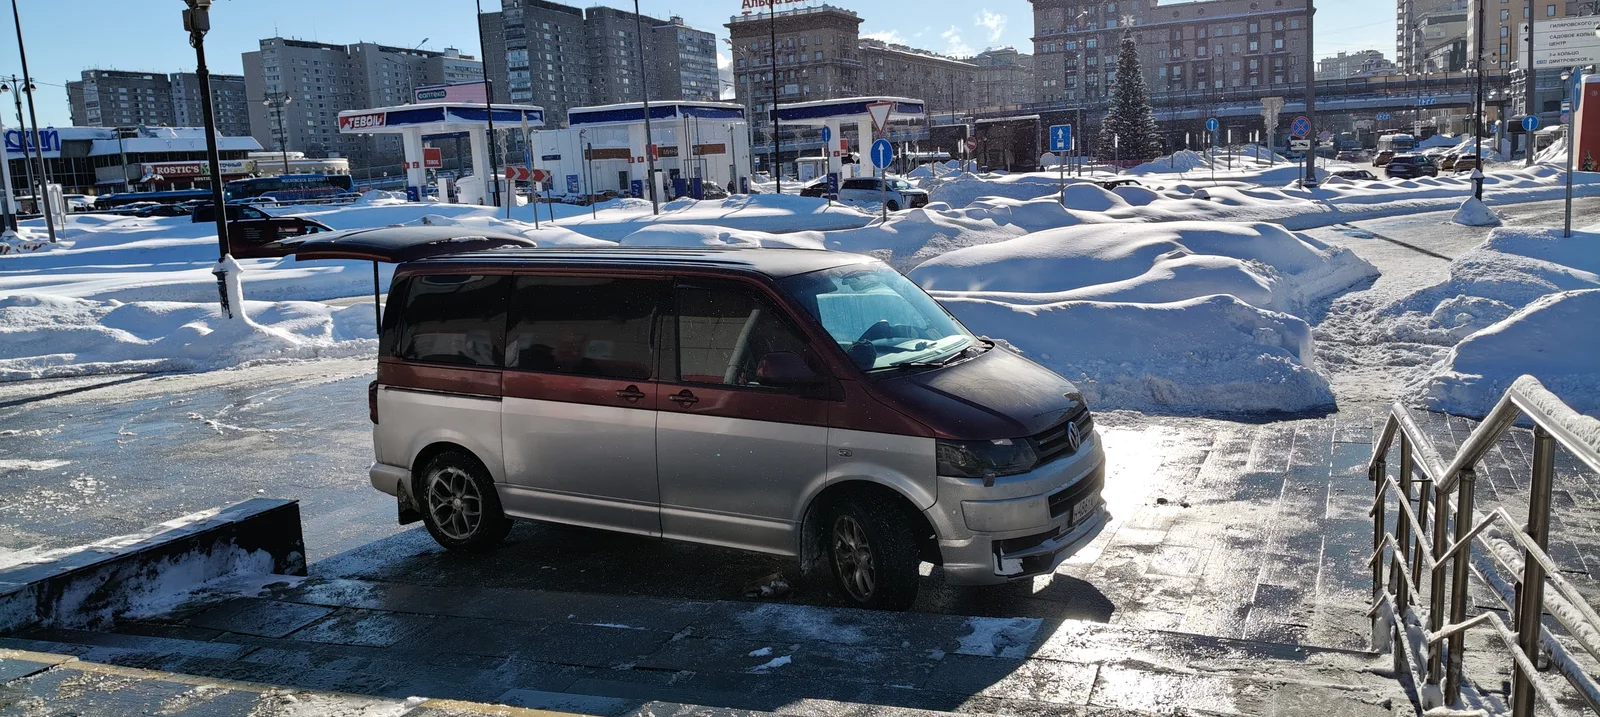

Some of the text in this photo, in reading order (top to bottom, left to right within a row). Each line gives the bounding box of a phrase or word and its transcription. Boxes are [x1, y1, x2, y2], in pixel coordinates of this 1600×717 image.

[1549, 21, 1592, 29] ГИЛЯРОВСКОГО
[1548, 57, 1588, 65] ДМИТРОВСКОЕ
[348, 115, 383, 129] TEBOIL
[156, 165, 200, 174] ROSTIC'S
